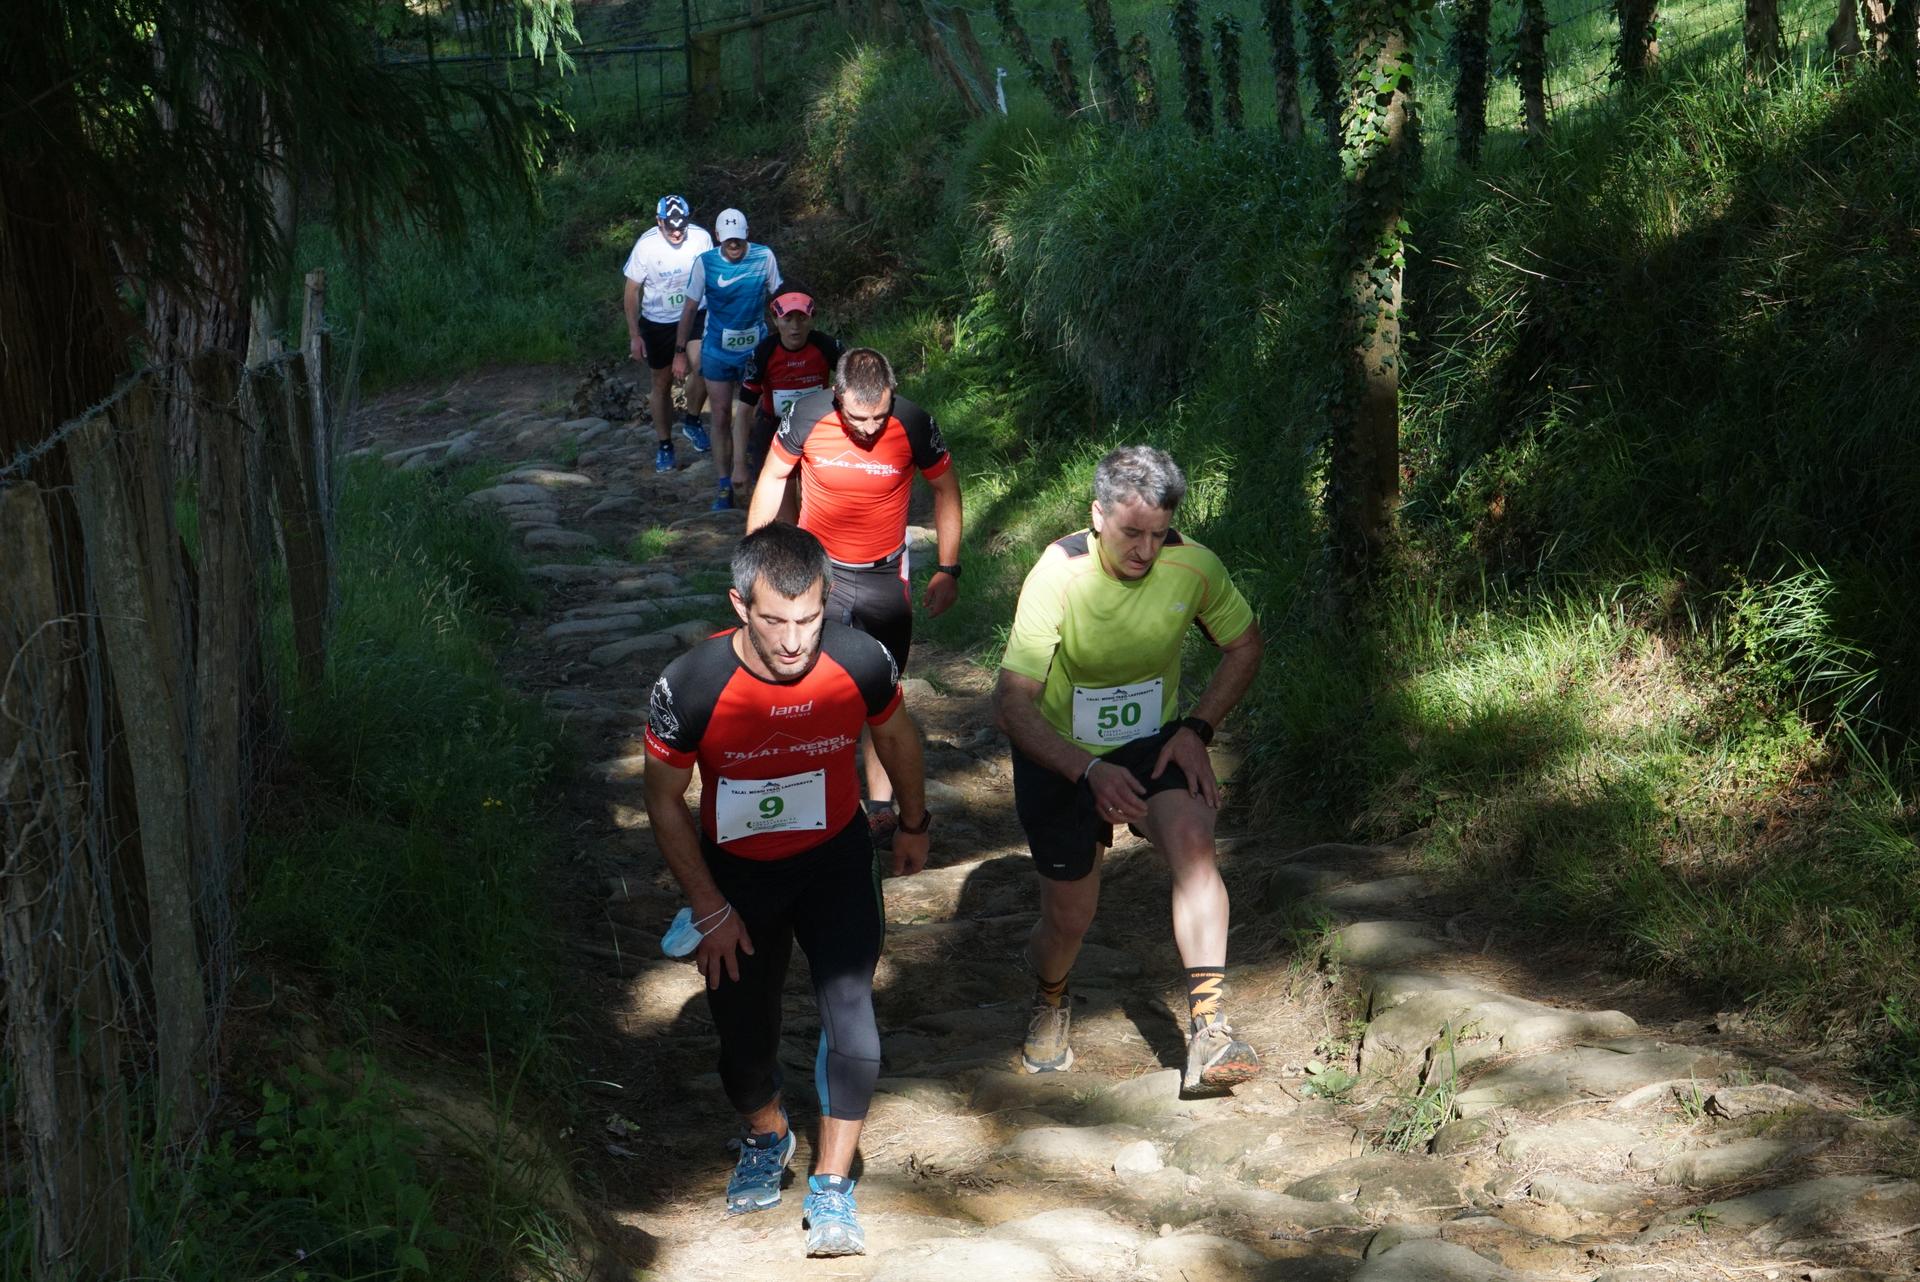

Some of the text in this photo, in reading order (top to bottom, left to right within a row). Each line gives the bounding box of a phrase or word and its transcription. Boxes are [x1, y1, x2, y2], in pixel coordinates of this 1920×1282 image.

[727, 335, 756, 347] 209
[770, 700, 813, 717] land
[1098, 702, 1141, 729] 50
[724, 734, 846, 760] TALAI MENDI
[806, 737, 857, 757] TRAIL
[759, 796, 784, 819] 9
